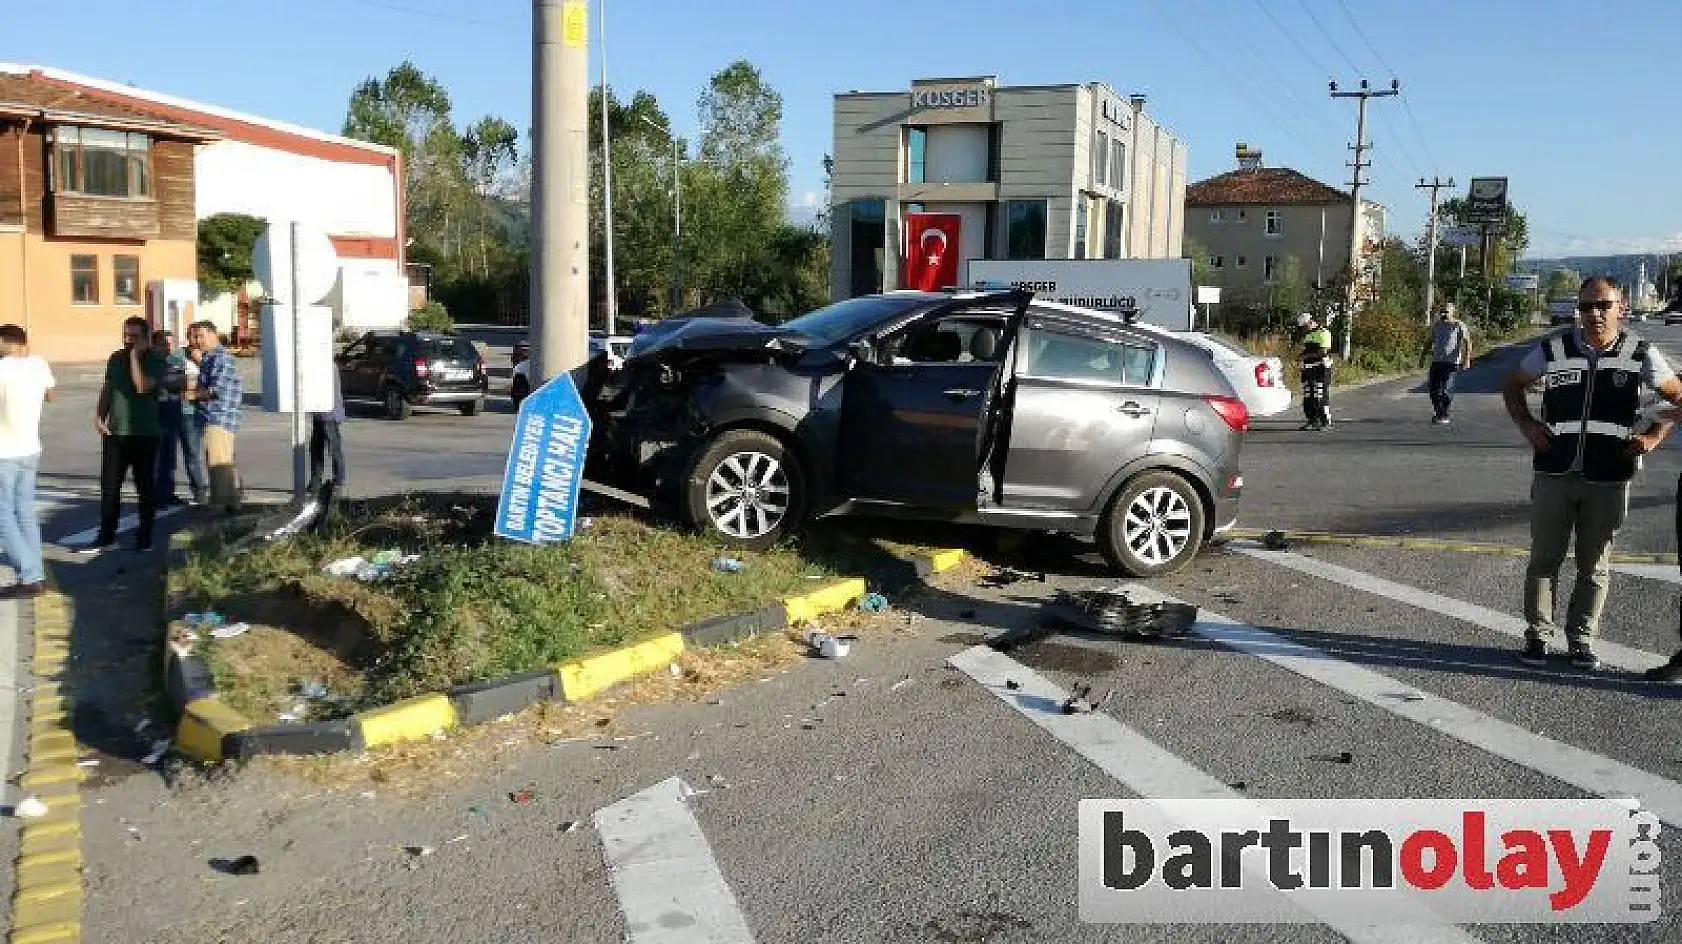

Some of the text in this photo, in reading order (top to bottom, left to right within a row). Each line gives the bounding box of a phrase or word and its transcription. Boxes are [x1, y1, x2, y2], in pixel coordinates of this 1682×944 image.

[914, 90, 990, 107] KOSGEB
[505, 484, 531, 530] BARTIN
[532, 457, 573, 541] TOPTANCI
